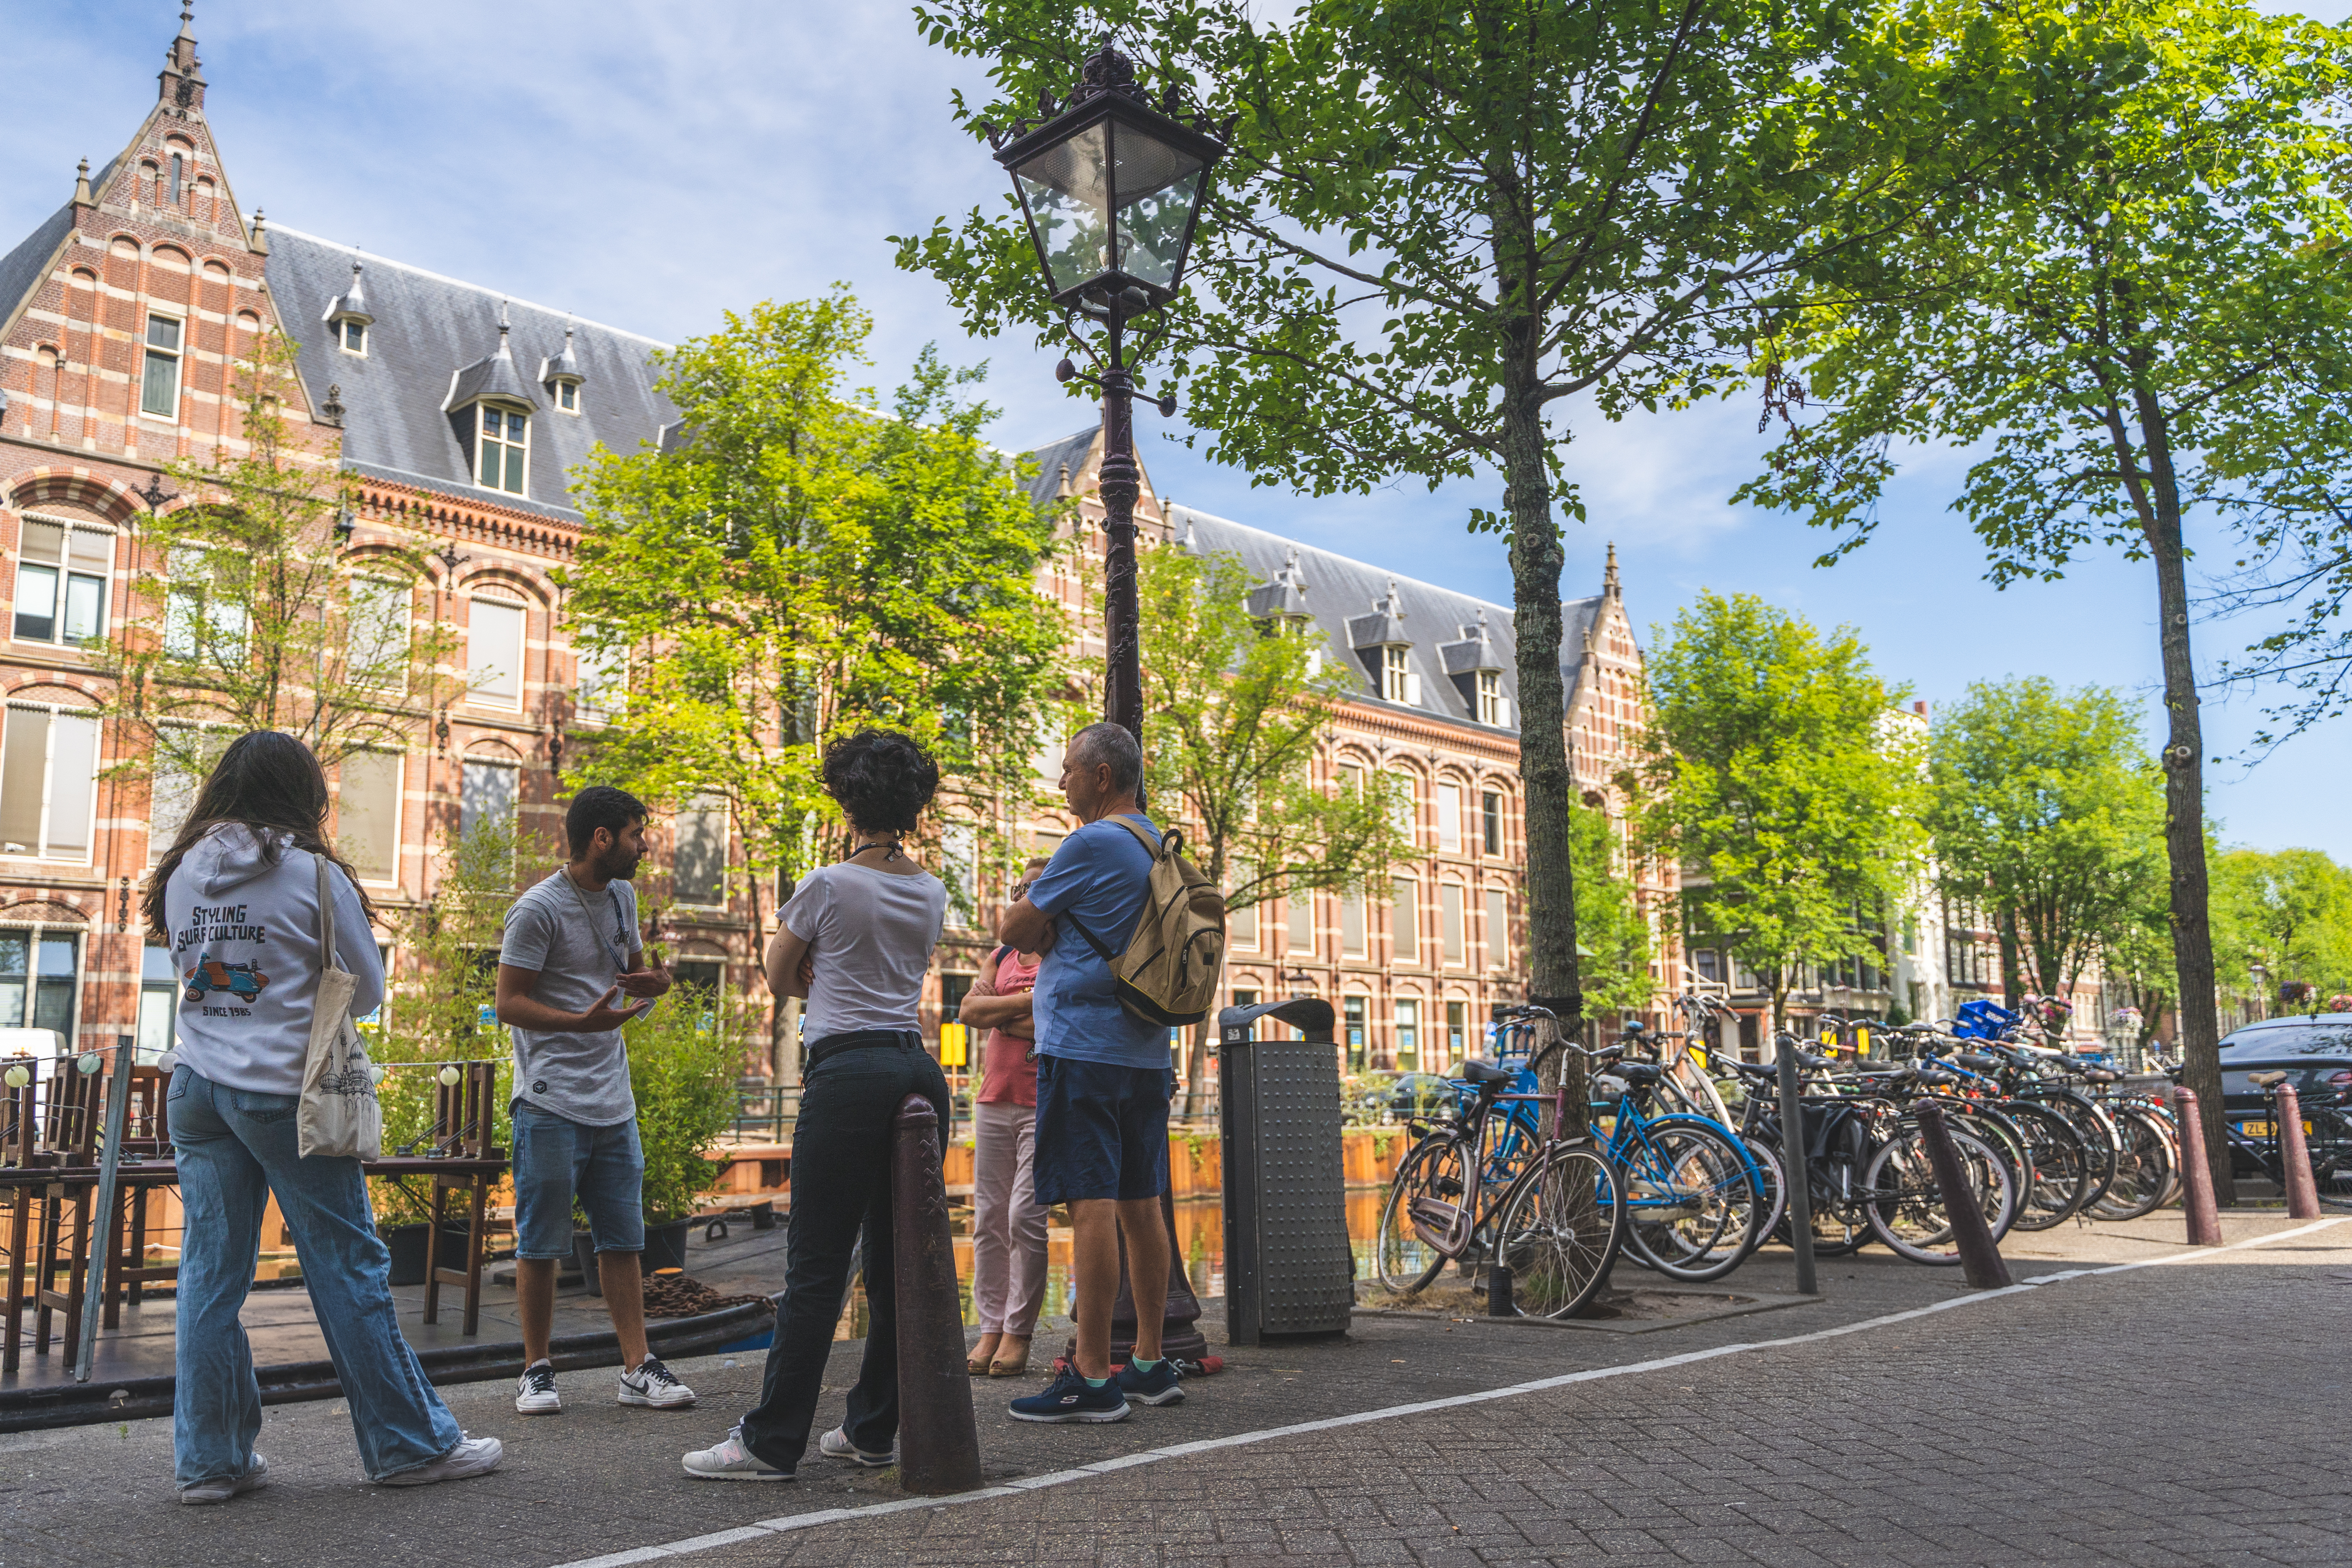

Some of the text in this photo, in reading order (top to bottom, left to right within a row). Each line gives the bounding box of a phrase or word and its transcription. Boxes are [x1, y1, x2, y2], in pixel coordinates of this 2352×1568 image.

[192, 904, 247, 926] STYLING
[177, 925, 266, 953] SURF CULTURE
[203, 1006, 251, 1016] SINCE 1985
[722, 1444, 743, 1464] N
